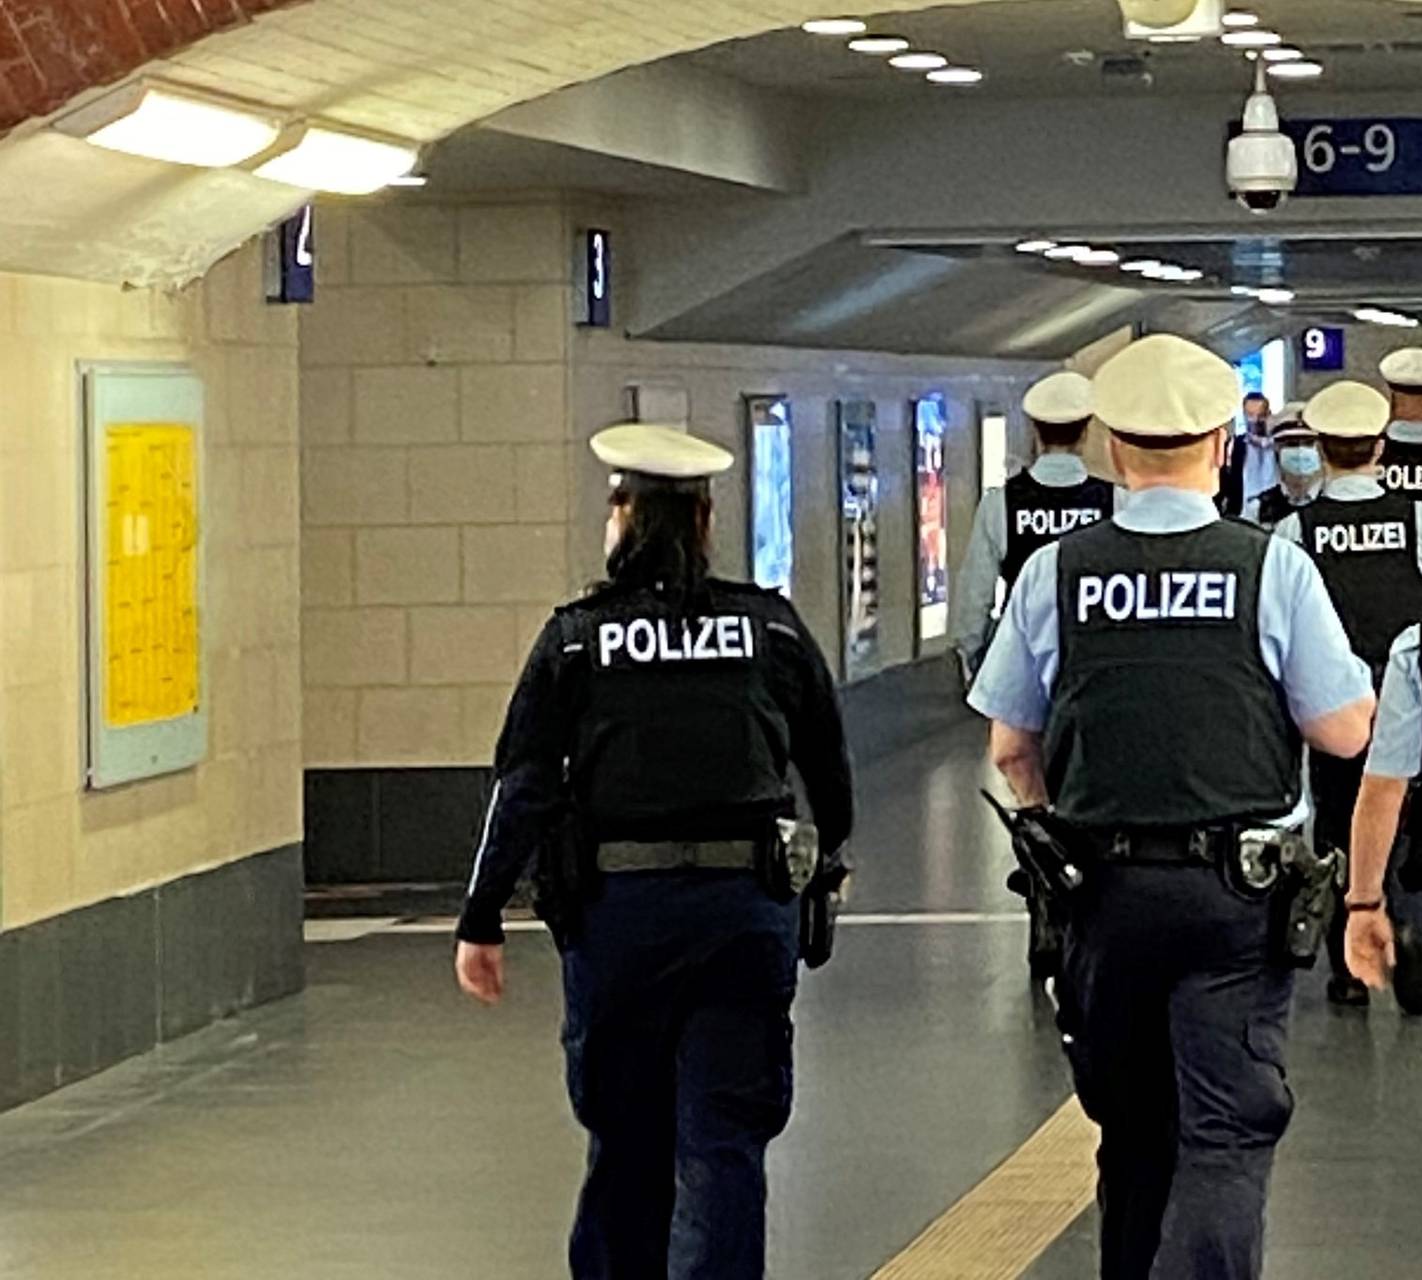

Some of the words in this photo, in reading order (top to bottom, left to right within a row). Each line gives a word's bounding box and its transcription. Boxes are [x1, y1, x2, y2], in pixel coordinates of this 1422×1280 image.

[1304, 124, 1395, 173] 6-9
[593, 233, 604, 299] 3
[1305, 328, 1326, 358] 9
[1315, 522, 1406, 553] POLIZEI
[1078, 572, 1237, 623] POLIZEI
[599, 615, 753, 667] POLIZEI
